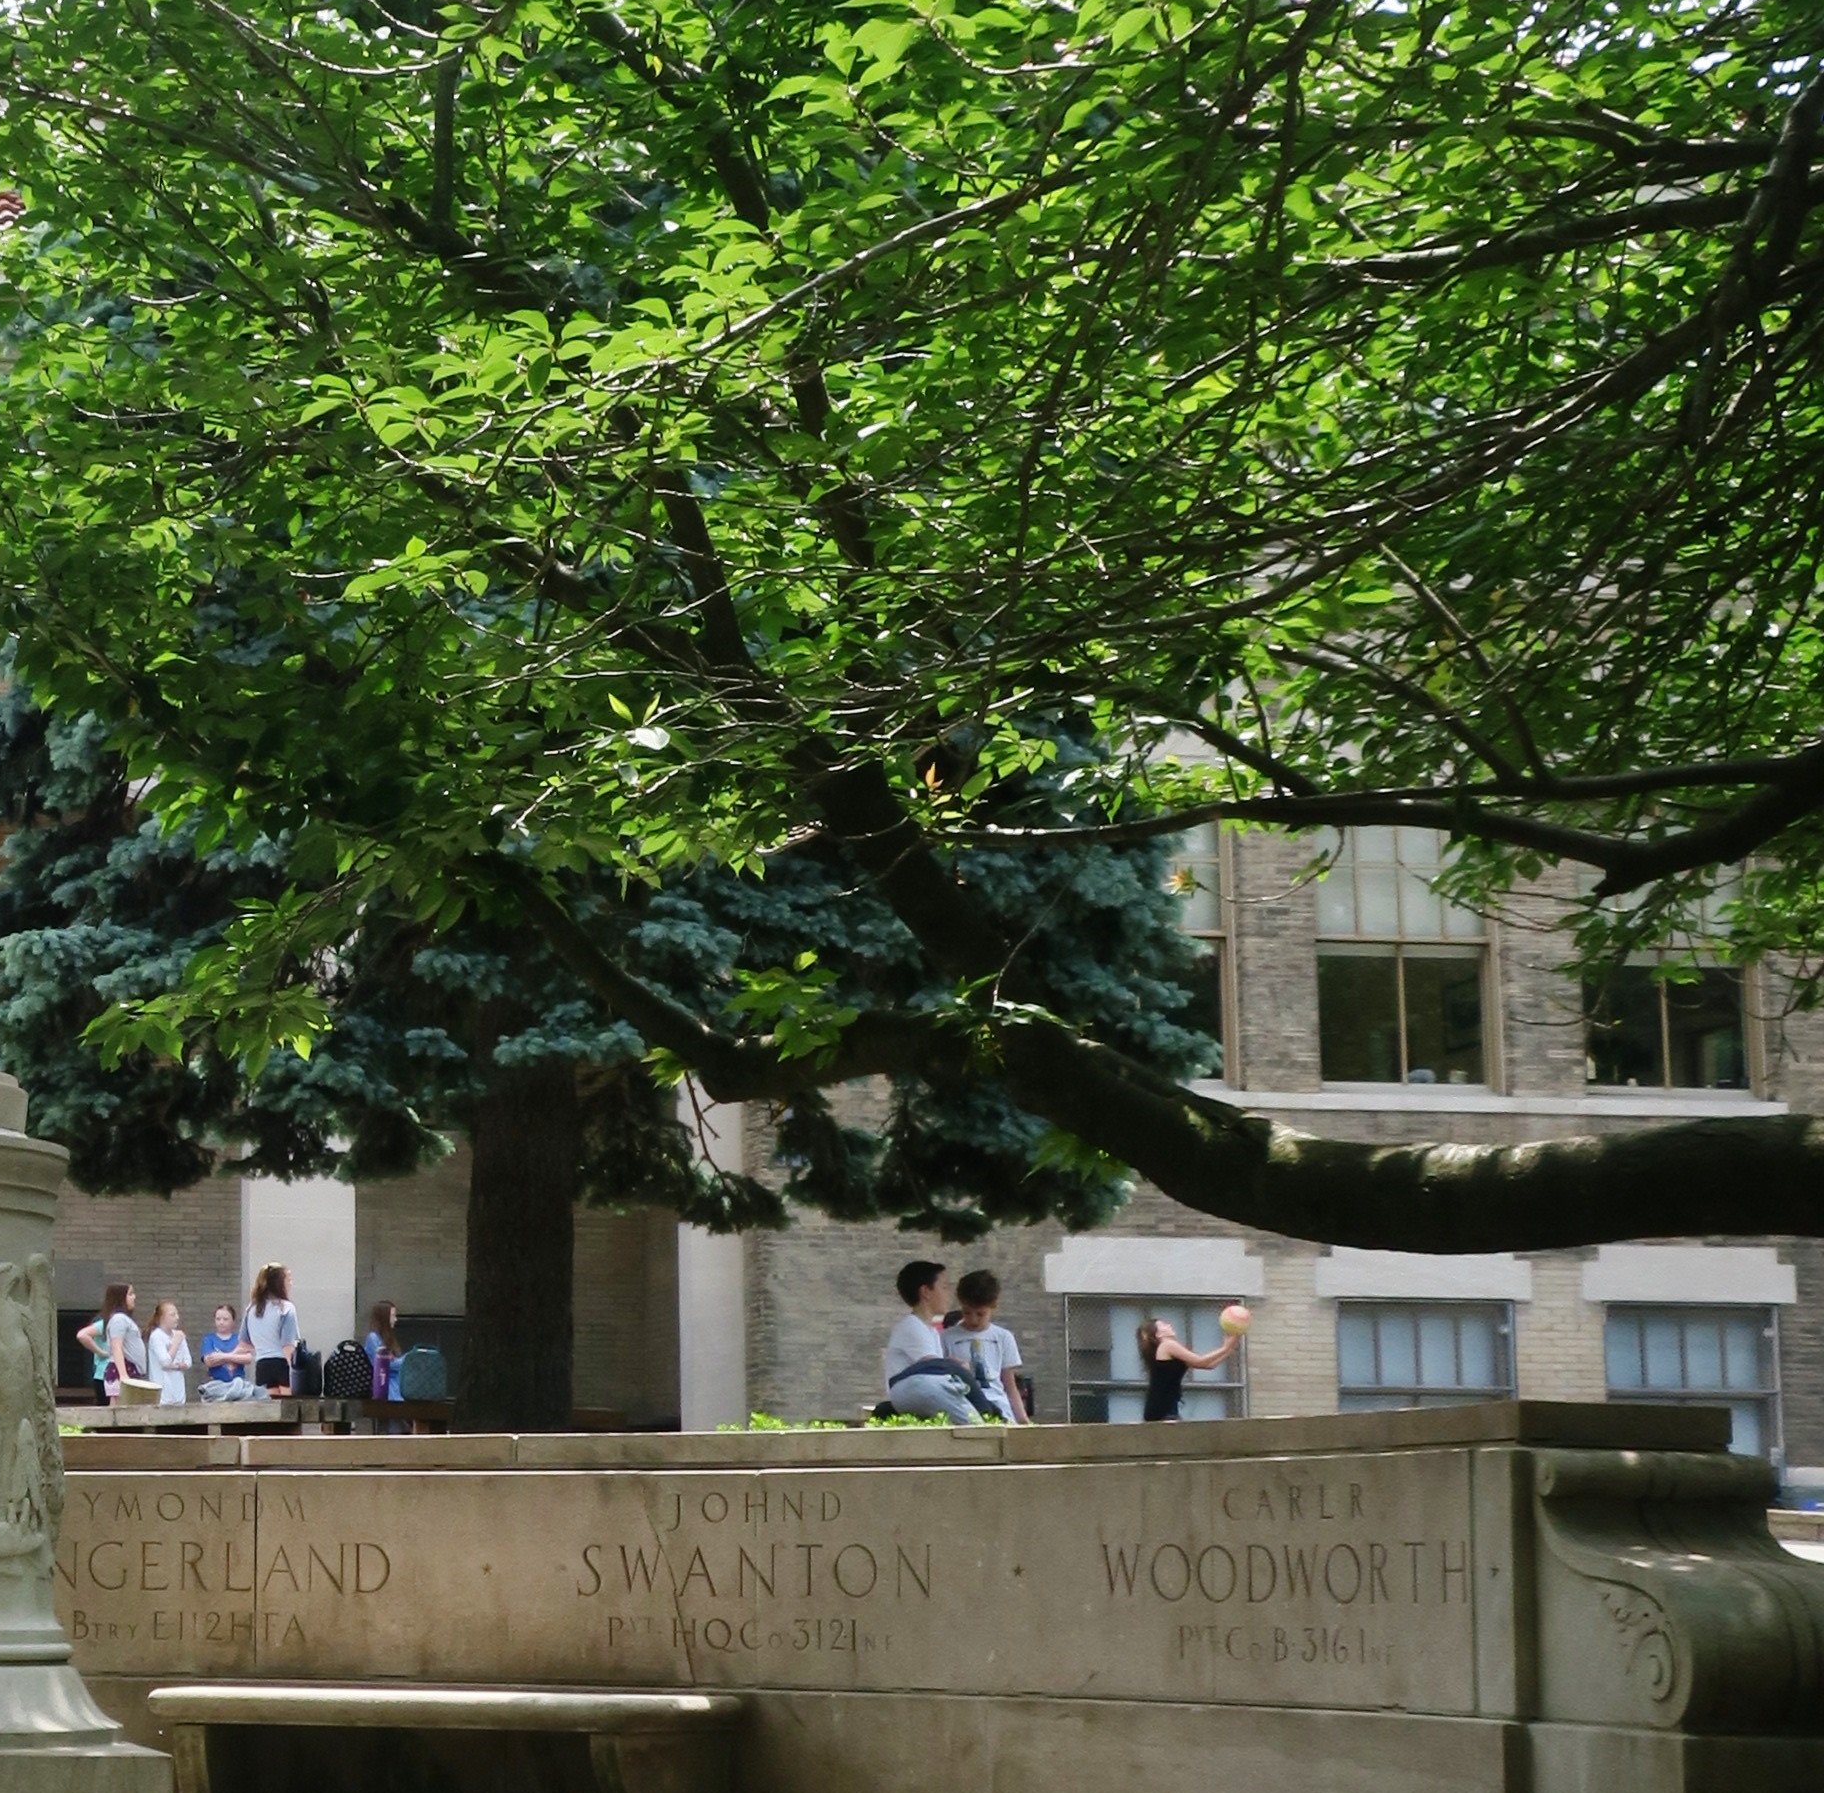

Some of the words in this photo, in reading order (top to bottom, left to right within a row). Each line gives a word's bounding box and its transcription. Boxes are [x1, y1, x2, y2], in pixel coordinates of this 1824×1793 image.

[667, 1491, 806, 1532] JOHN
[820, 1491, 842, 1522] D
[1222, 1485, 1335, 1521] CARL
[577, 1543, 932, 1599] SWANTON
[1101, 1541, 1468, 1604] WOODWORTH
